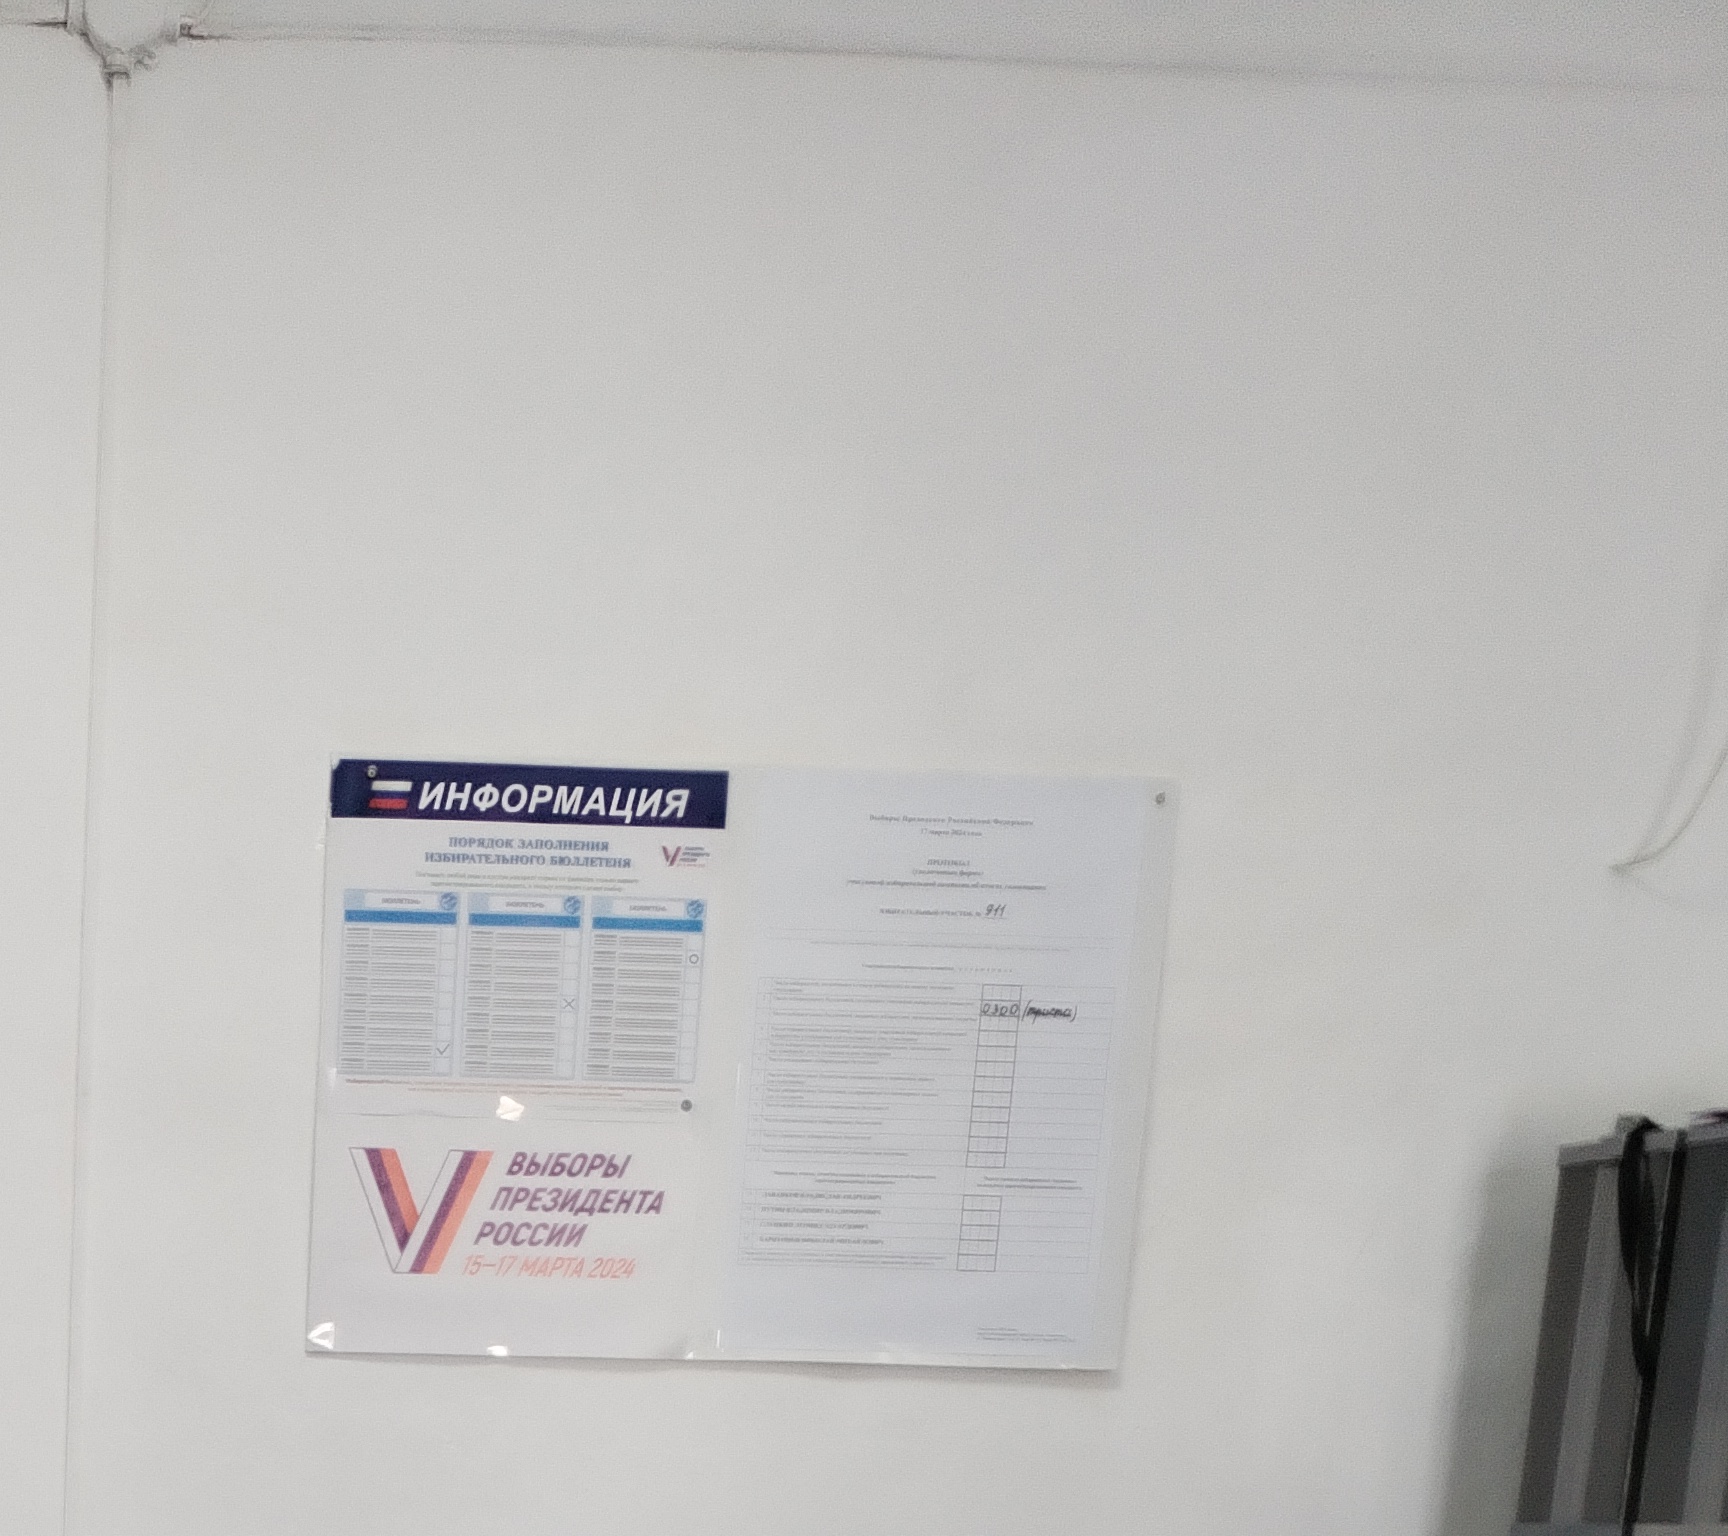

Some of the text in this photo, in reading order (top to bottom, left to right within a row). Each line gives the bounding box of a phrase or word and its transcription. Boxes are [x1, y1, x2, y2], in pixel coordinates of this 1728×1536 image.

[418, 781, 690, 824] ИНФОРМАЦИЯ
[449, 837, 610, 852] ПОРЯДОК ЗАПОЛНЕНИЯ
[425, 852, 632, 869] ИЗБИРАТЕЛЬНОГО БЮЛЛЕТЕНЯ
[506, 1151, 632, 1179] ВЫБОРЫ
[489, 1186, 665, 1217] ПРЕЗИДЕНТА
[473, 1221, 588, 1248] РОССИИ
[518, 1256, 586, 1278] МАРТА
[587, 1257, 636, 1279] 2024
